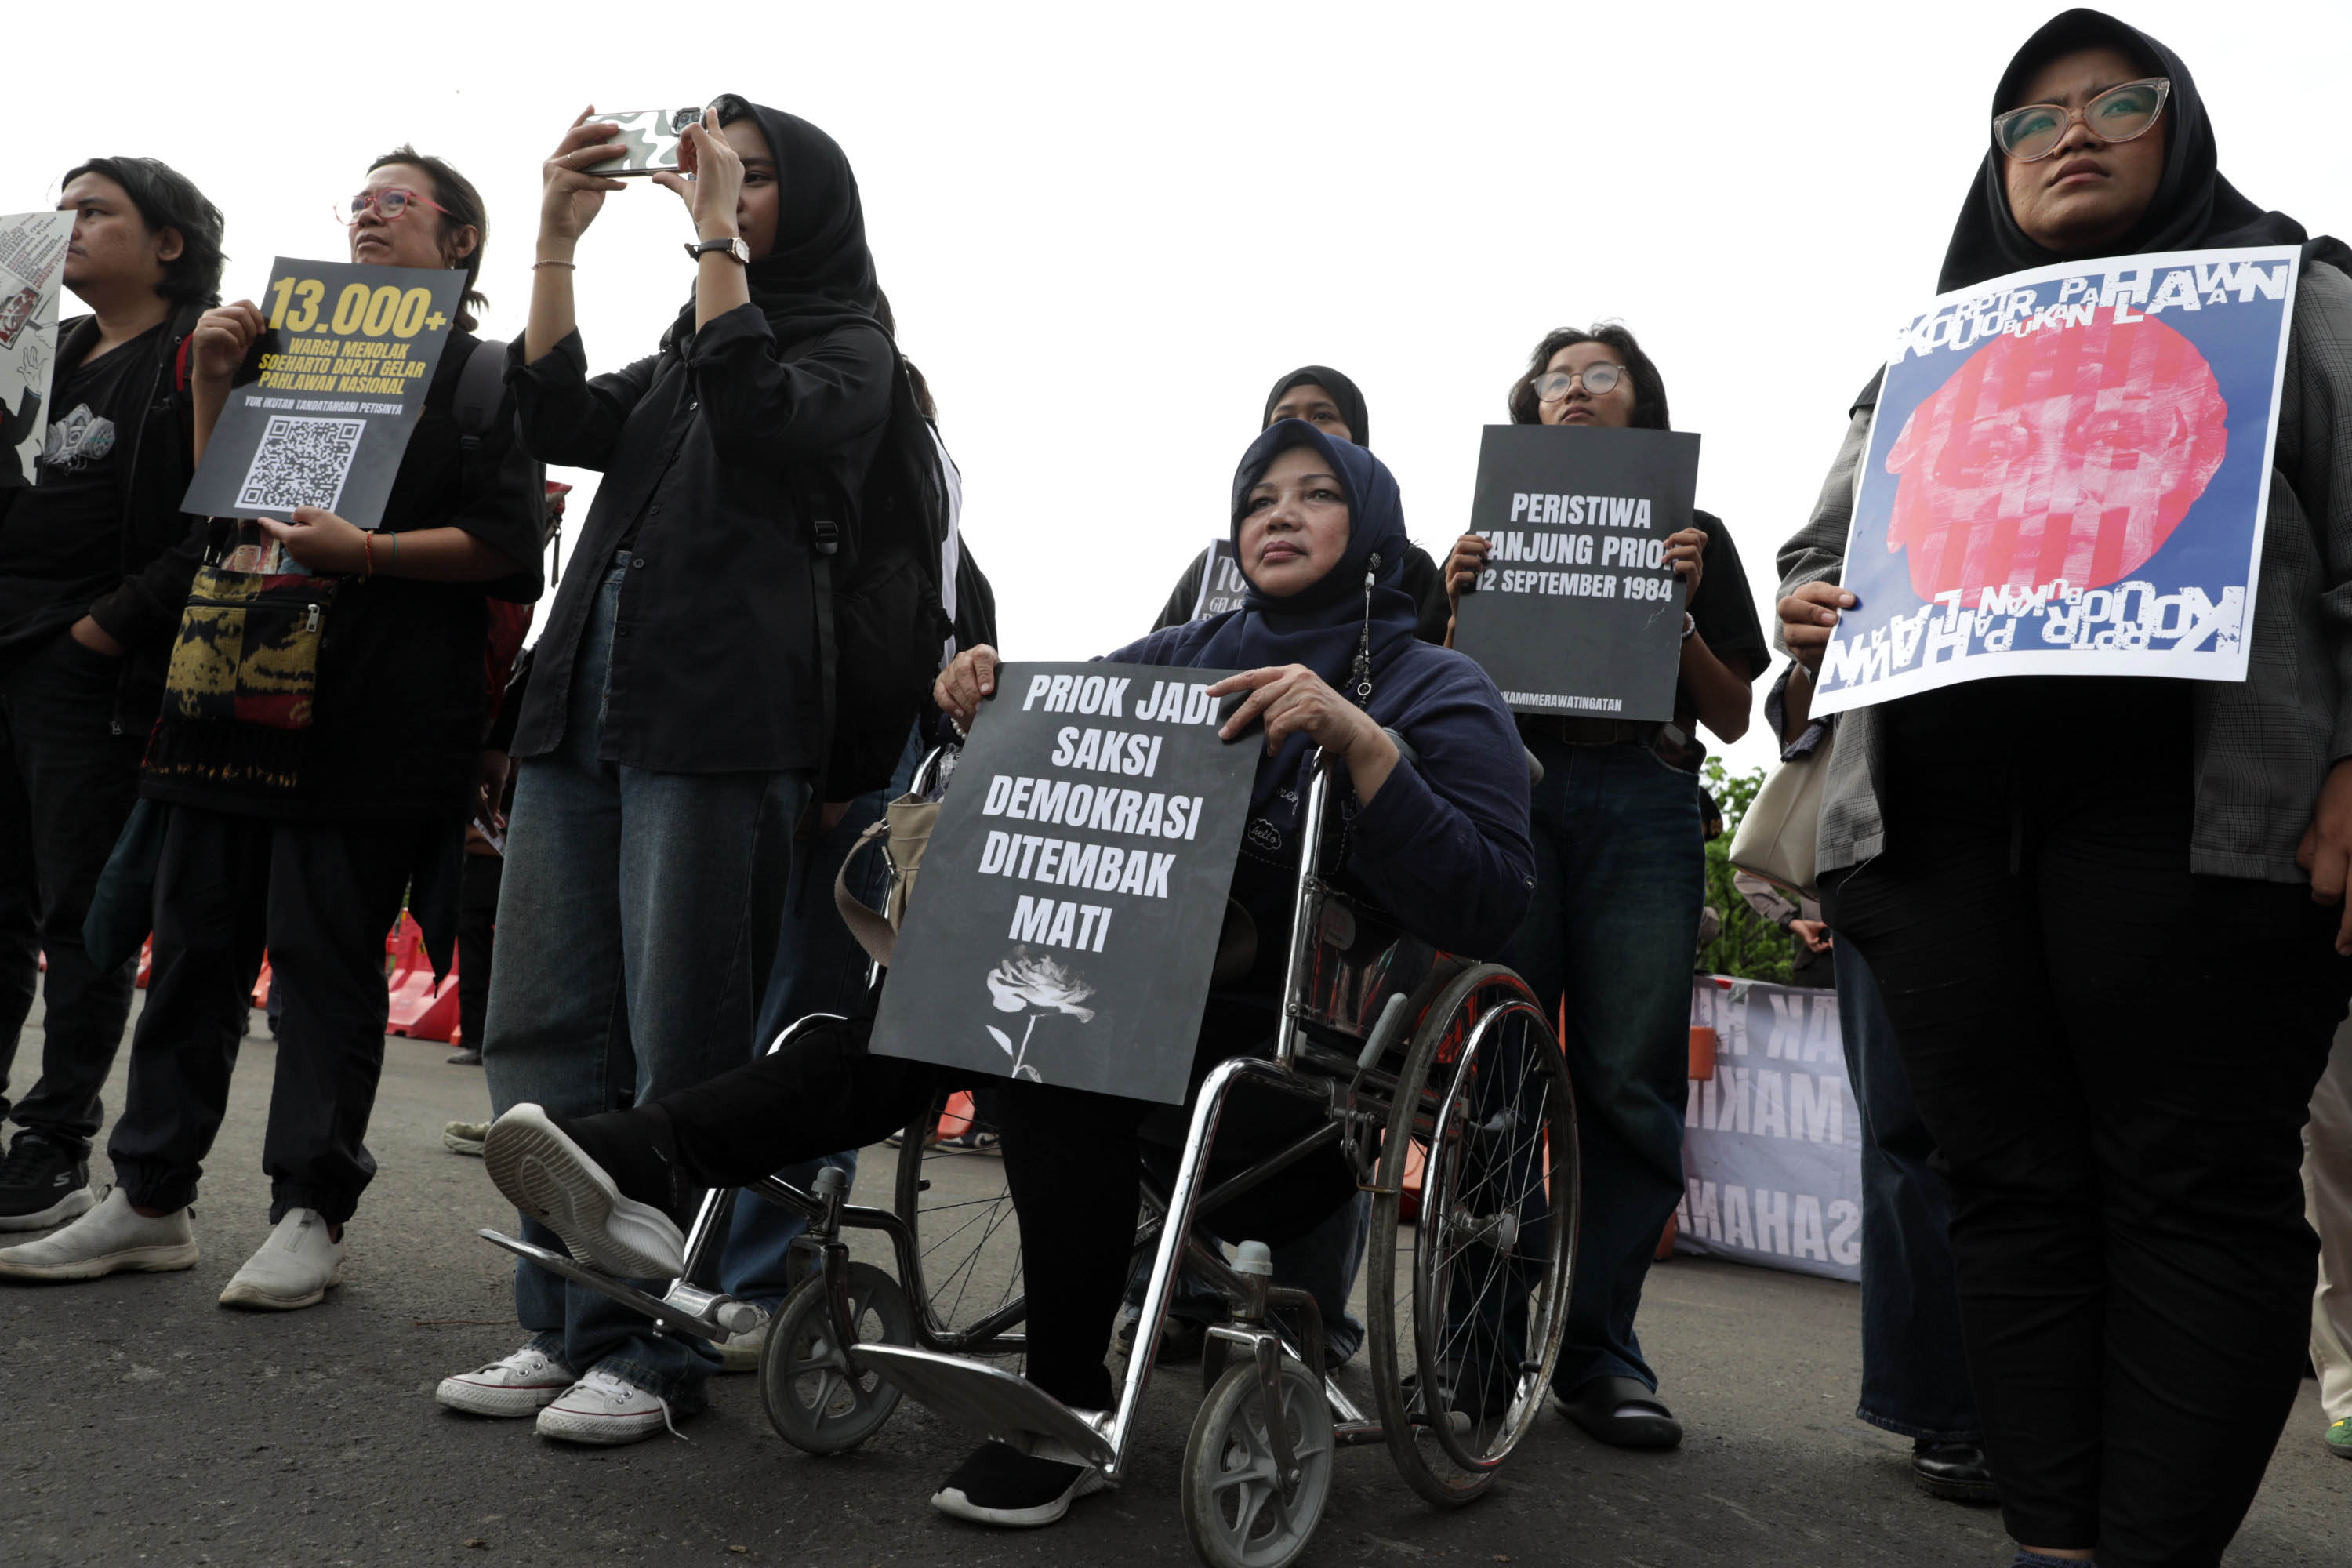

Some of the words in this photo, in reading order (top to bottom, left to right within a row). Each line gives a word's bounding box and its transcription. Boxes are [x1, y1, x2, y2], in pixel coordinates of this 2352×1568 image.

[269, 277, 447, 338] 13.000+
[258, 354, 332, 374] SOEHARTO
[332, 358, 379, 376] DAPAT
[379, 361, 426, 378] GELAR
[289, 337, 339, 356] WARGA
[341, 341, 411, 360] MENOLAK
[257, 371, 338, 391] PAHLAWAN
[337, 376, 405, 394] NASIONAL
[245, 395, 266, 408] YUK
[263, 397, 295, 410] IKUTAN
[296, 399, 360, 413] TANDATANGANI
[358, 402, 404, 416] PETISINYA
[1510, 493, 1651, 528] PERISTIWA
[1601, 535, 1680, 571] PRIO
[1475, 568, 1497, 592] 12
[1501, 569, 1617, 598] SEPTEMBER
[1623, 576, 1673, 602] 1984
[1022, 674, 1131, 718] PRIOK
[1135, 681, 1221, 726] JADI
[1501, 691, 1622, 711] KAMIMERAWATINGATAN
[1051, 726, 1163, 778] SAKSI
[982, 775, 1203, 840] DEMOKRASI
[978, 830, 1176, 898] DITEMBAK
[1008, 895, 1112, 953] MATI
